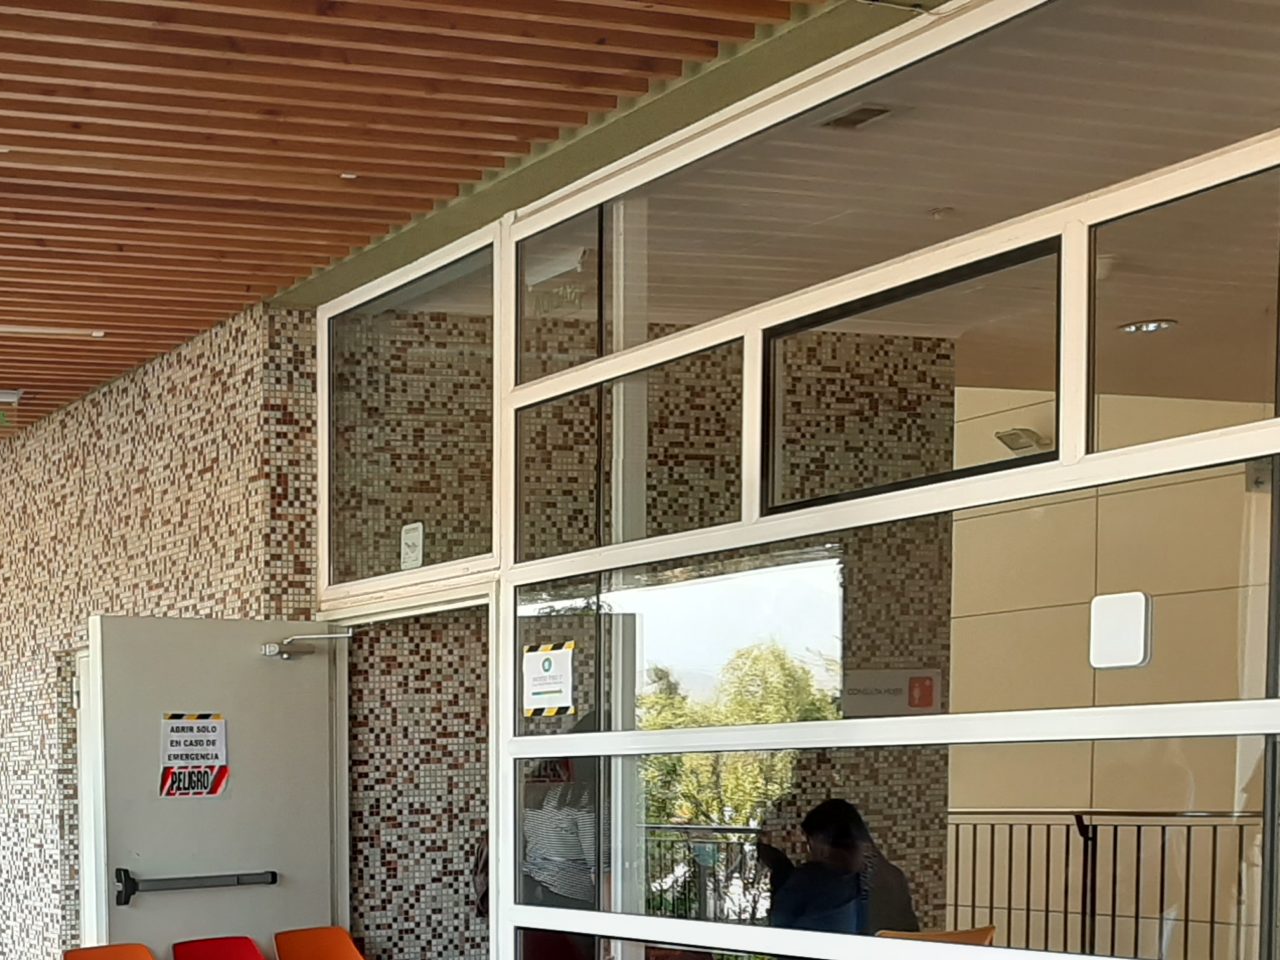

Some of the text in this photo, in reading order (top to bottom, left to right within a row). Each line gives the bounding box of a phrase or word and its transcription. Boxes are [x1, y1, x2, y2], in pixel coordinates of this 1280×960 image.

[170, 725, 217, 733] ABRIR SOLO
[169, 739, 217, 747] EN CASO DE
[167, 753, 219, 761] EMERGENCIA
[170, 770, 209, 791] PELIGRO
